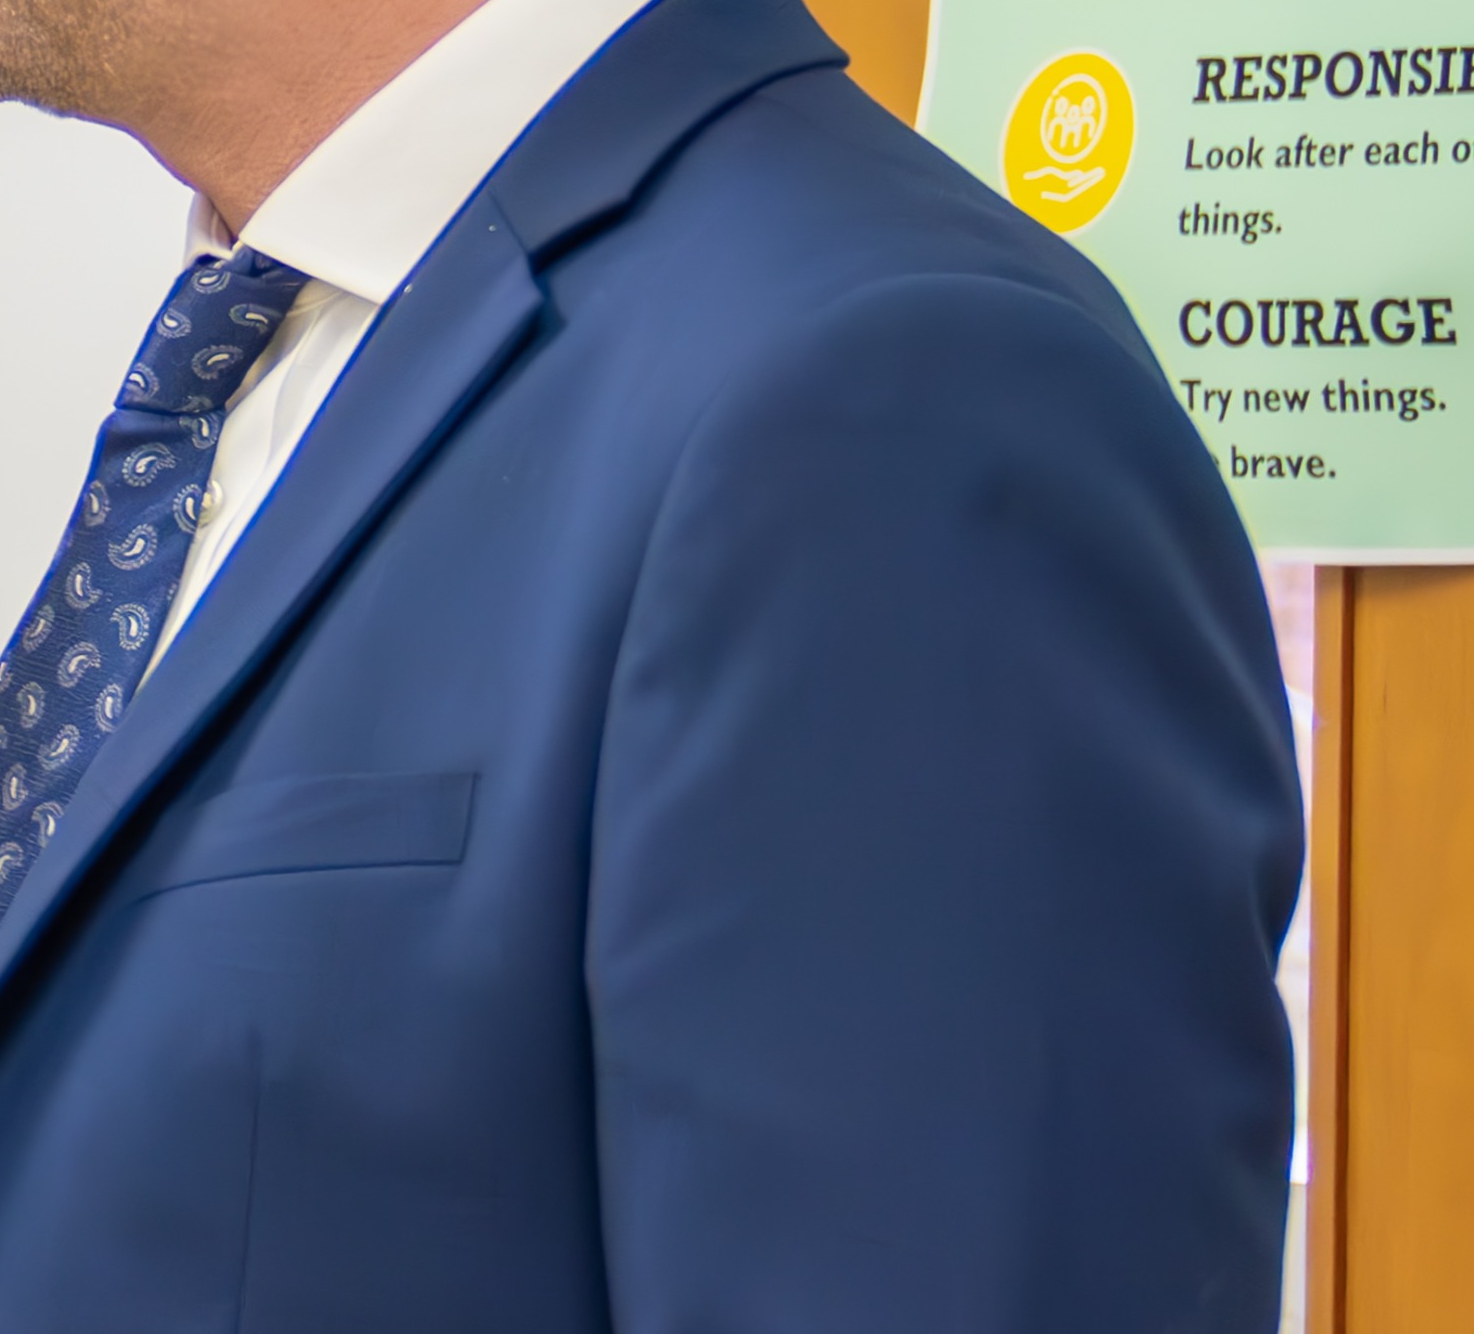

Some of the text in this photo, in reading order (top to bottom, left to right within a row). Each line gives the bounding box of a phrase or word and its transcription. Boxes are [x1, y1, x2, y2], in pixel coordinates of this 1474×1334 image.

[1185, 129, 1474, 171] Look after each o
[1178, 202, 1283, 244] things.
[1179, 296, 1458, 349] COURAGE
[1180, 377, 1447, 424] Try new things.
[1231, 443, 1337, 480] brave.
